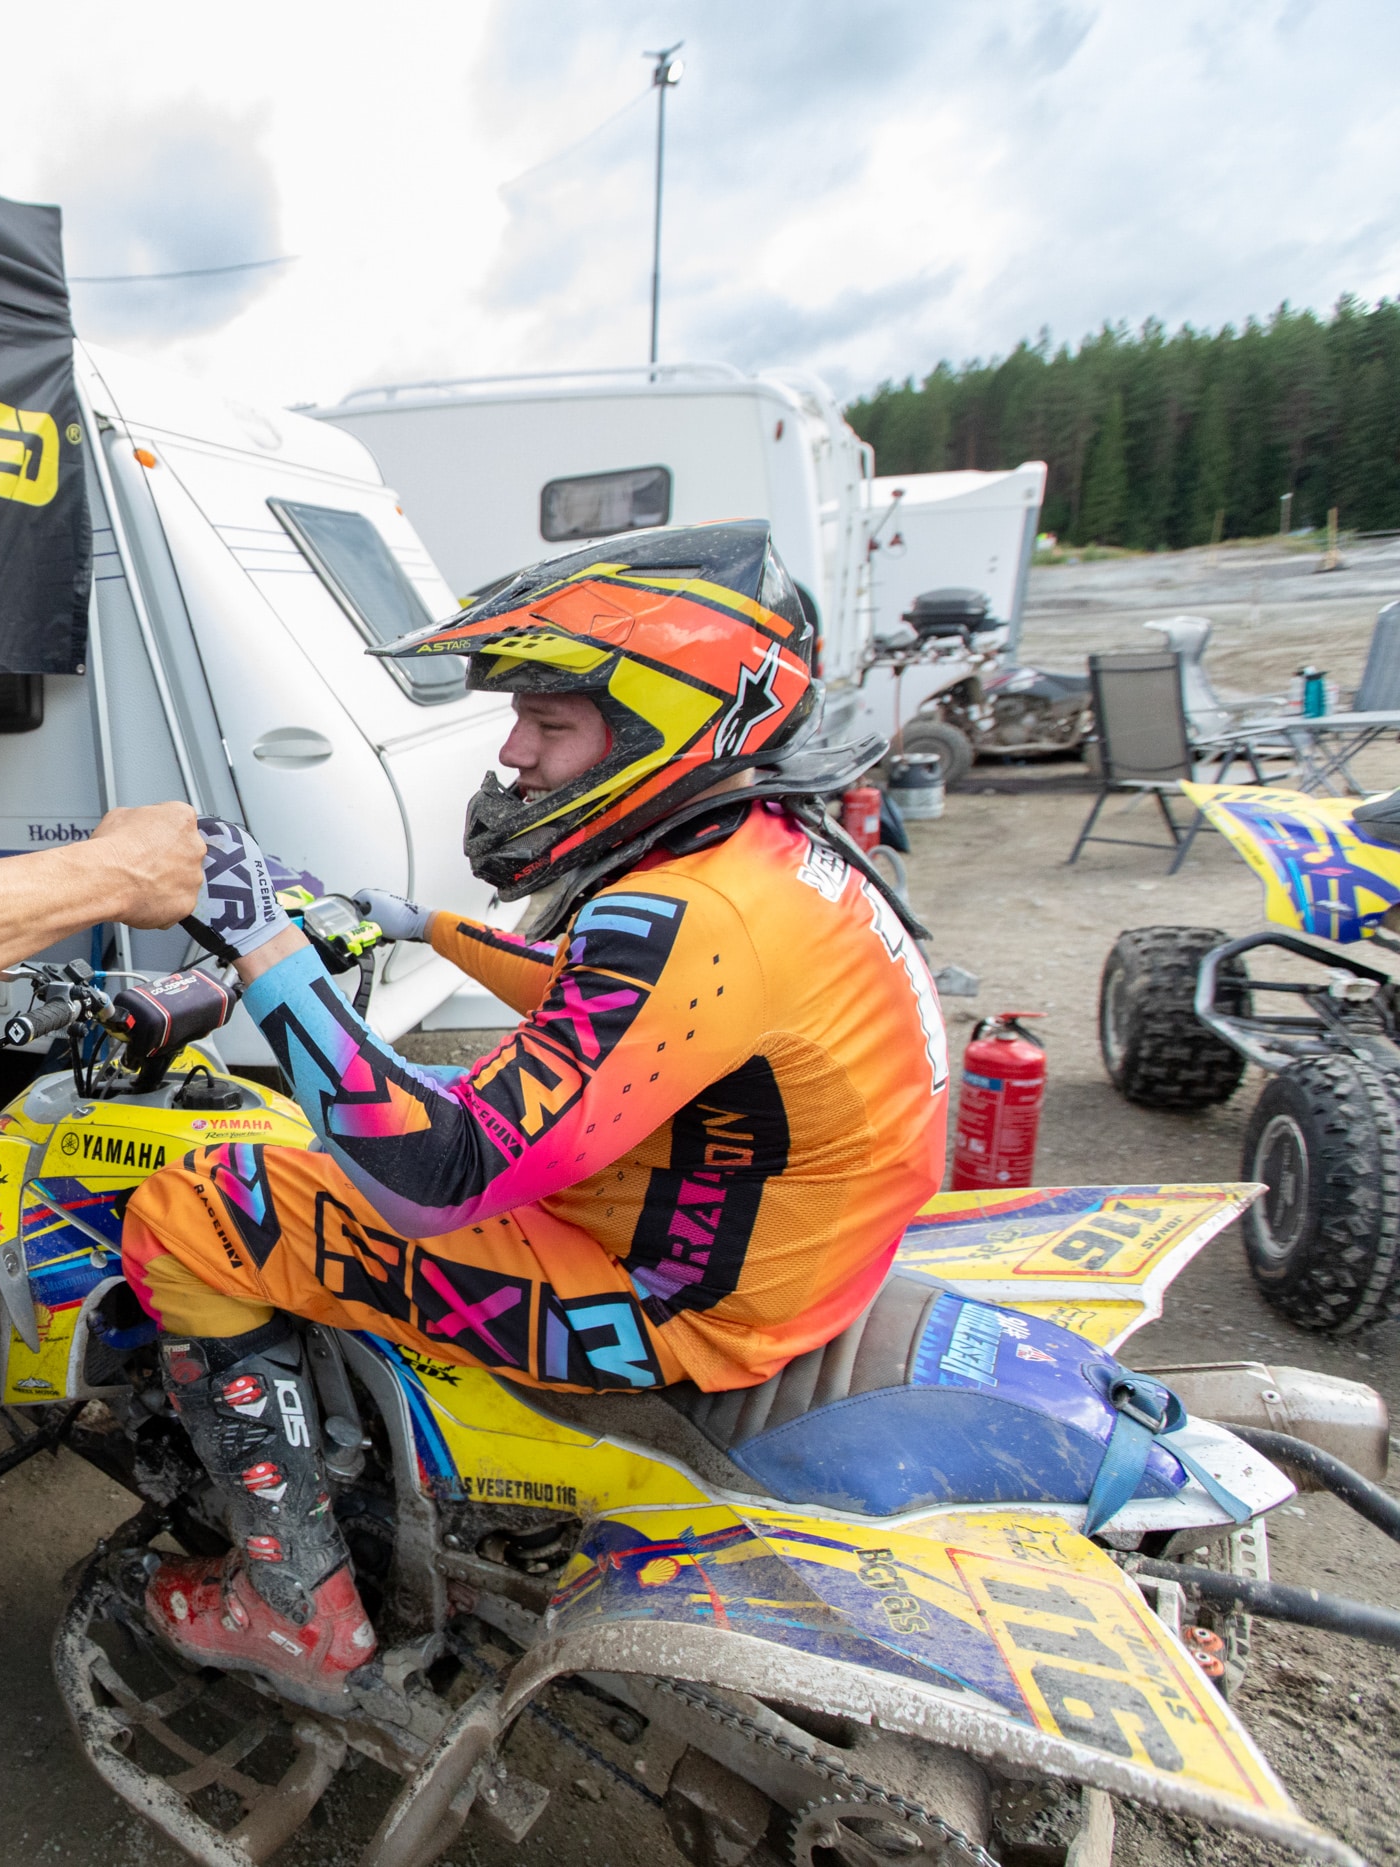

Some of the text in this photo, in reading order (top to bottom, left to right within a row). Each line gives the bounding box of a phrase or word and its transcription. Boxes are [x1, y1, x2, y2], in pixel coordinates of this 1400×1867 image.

[416, 640, 472, 654] ASTARS
[209, 1119, 273, 1131] YAMAHA
[83, 1133, 167, 1170] YAMAHA
[1141, 1214, 1183, 1251] JONAS
[401, 1356, 463, 1387] FOX
[477, 1477, 553, 1504] VESETRUD
[556, 1485, 577, 1508] 116
[855, 1547, 931, 1636] BGT as
[980, 1577, 1186, 1773] 116
